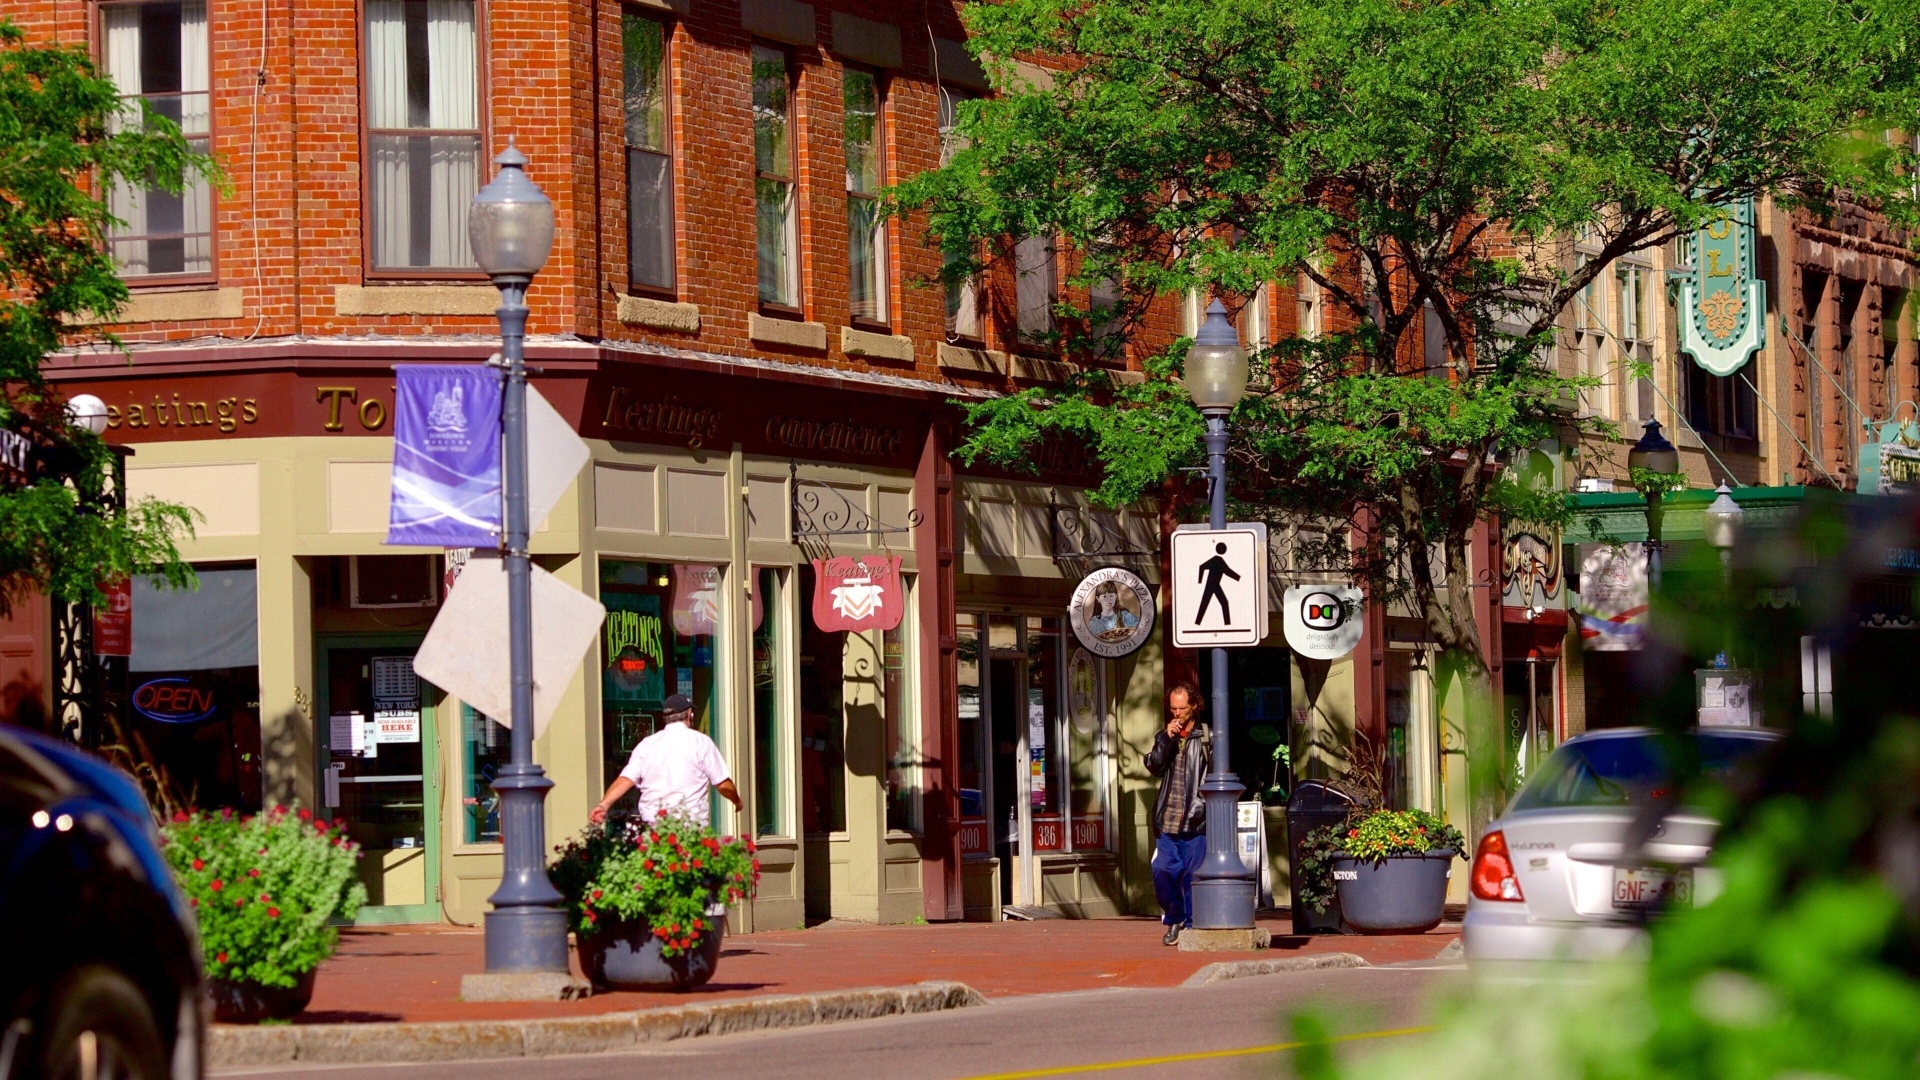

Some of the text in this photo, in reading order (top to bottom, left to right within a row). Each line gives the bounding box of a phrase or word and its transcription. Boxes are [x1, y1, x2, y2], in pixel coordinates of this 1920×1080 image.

[1073, 570, 1150, 612] ALEXANDRA'S PIZZA
[605, 609, 664, 668] KEATINGS
[1093, 639, 1137, 655] EST. 1991
[1306, 633, 1340, 642] delightfully
[136, 685, 213, 712] OPEN
[1038, 825, 1056, 846] 386
[1074, 823, 1098, 844] 1900
